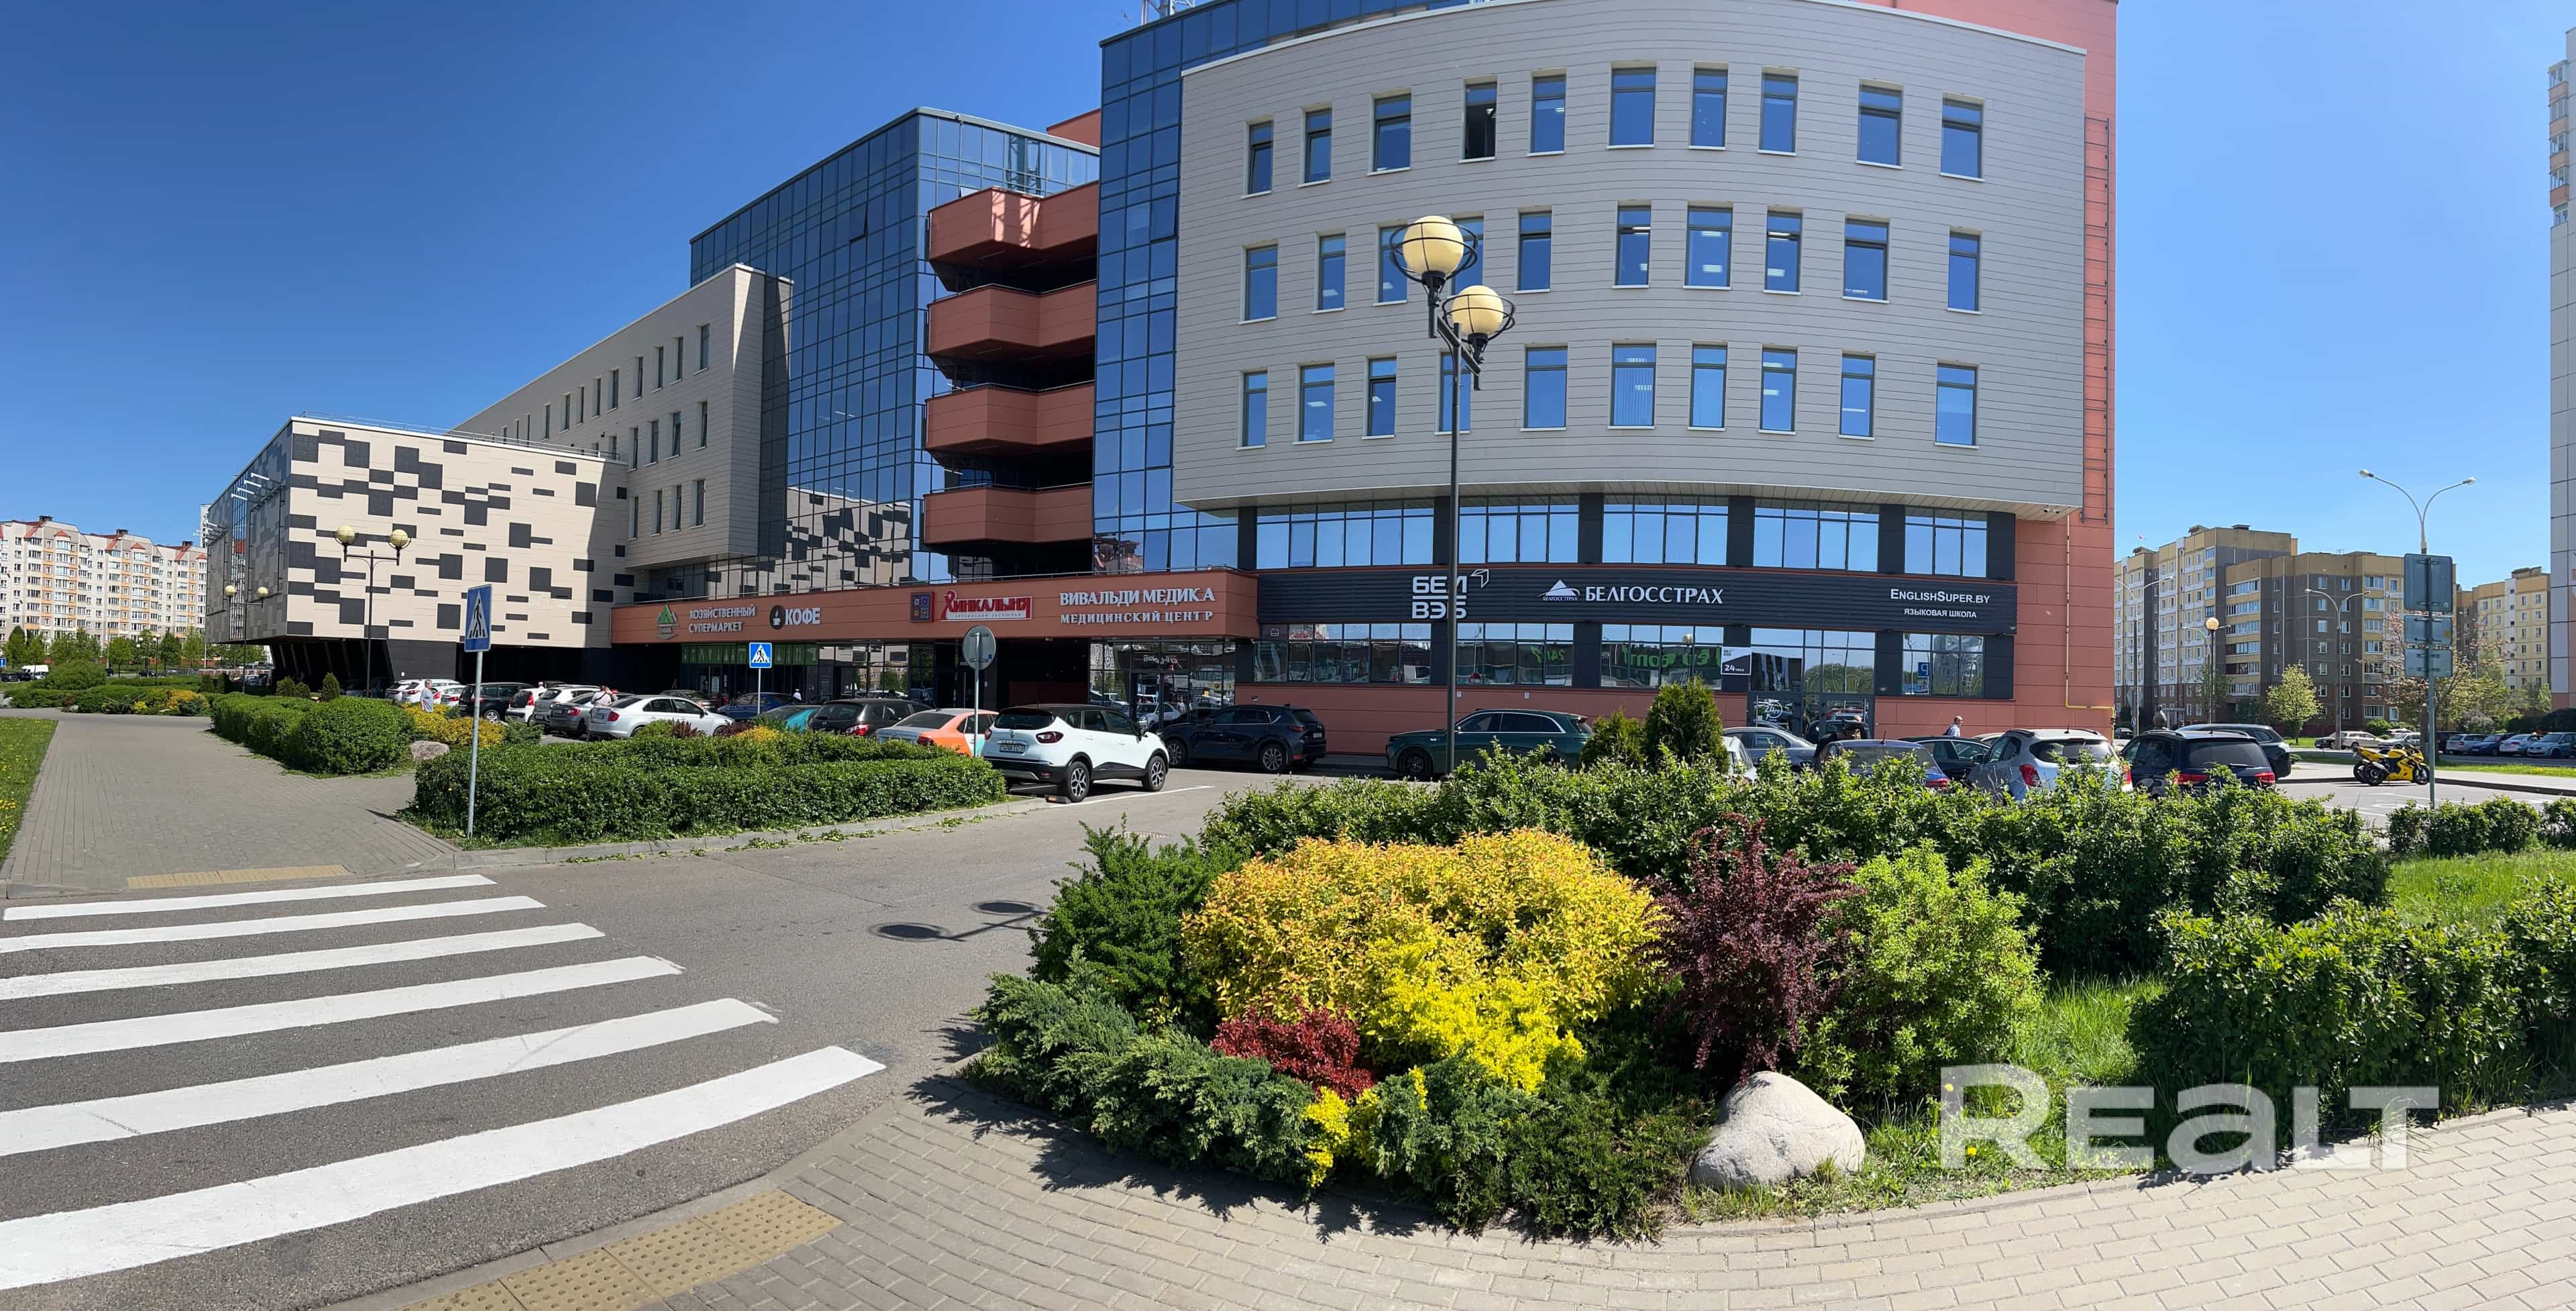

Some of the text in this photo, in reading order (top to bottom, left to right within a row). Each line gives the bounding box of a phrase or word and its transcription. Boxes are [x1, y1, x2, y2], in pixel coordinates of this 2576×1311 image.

[1412, 576, 1467, 594] БЕЛ
[1059, 587, 1216, 607] ВИВАЛЬДИ МЕДИКА
[1586, 586, 1723, 604] БЕЛГОССТРАХ
[689, 605, 756, 619] ХОЗЯЙСТВЕННЫЙ
[785, 607, 821, 625] КОФЕ
[1061, 610, 1214, 625] МЕДИЦИНСКИЙ ЦЕНТР
[1904, 608, 1977, 618] ЯЗЫКОВАЯ ШКОЛА
[688, 621, 743, 633] СУПЕРМАРКЕТ
